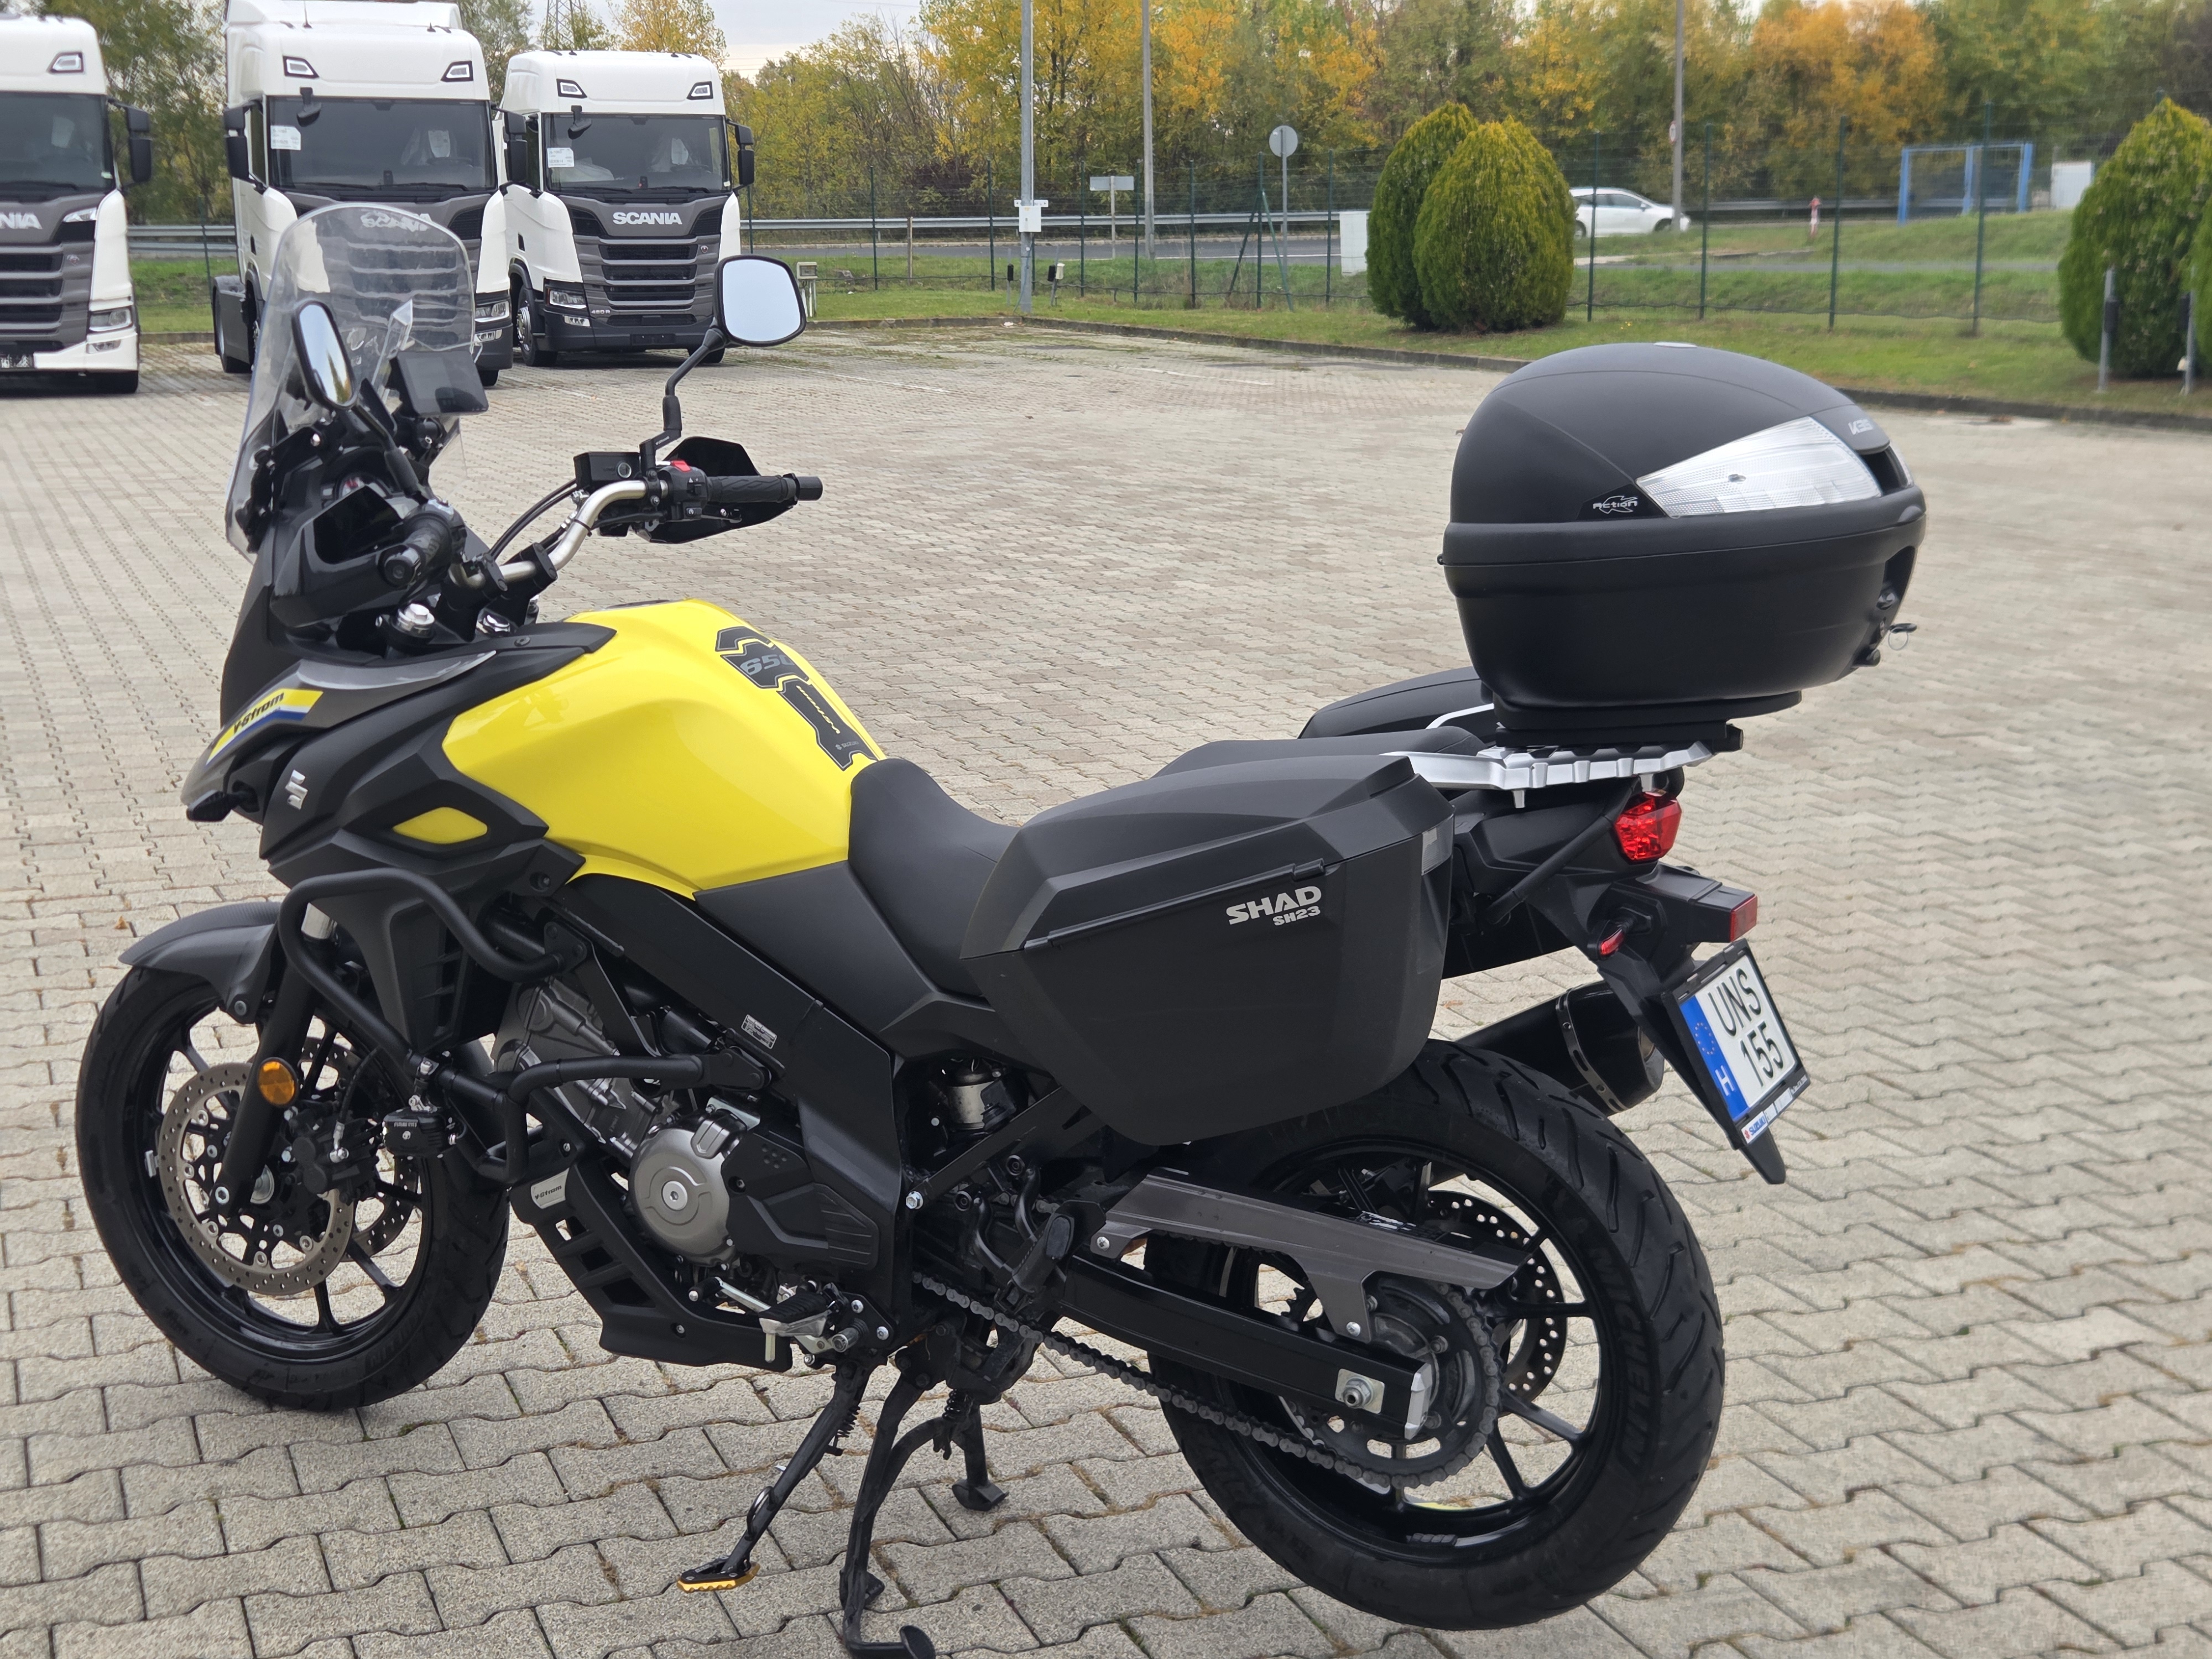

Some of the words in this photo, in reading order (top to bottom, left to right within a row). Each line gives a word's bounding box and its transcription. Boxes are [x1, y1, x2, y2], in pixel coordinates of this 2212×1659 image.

[613, 212, 682, 225] SCANIA
[740, 654, 795, 676] 650
[234, 692, 285, 734] V-Strom
[1226, 886, 1322, 925] SHAD
[1272, 905, 1321, 926] SH23
[1707, 968, 1761, 1037] UNS
[1740, 1021, 1784, 1088] 155
[1715, 1065, 1735, 1097] H
[535, 1185, 562, 1200] V-Strom
